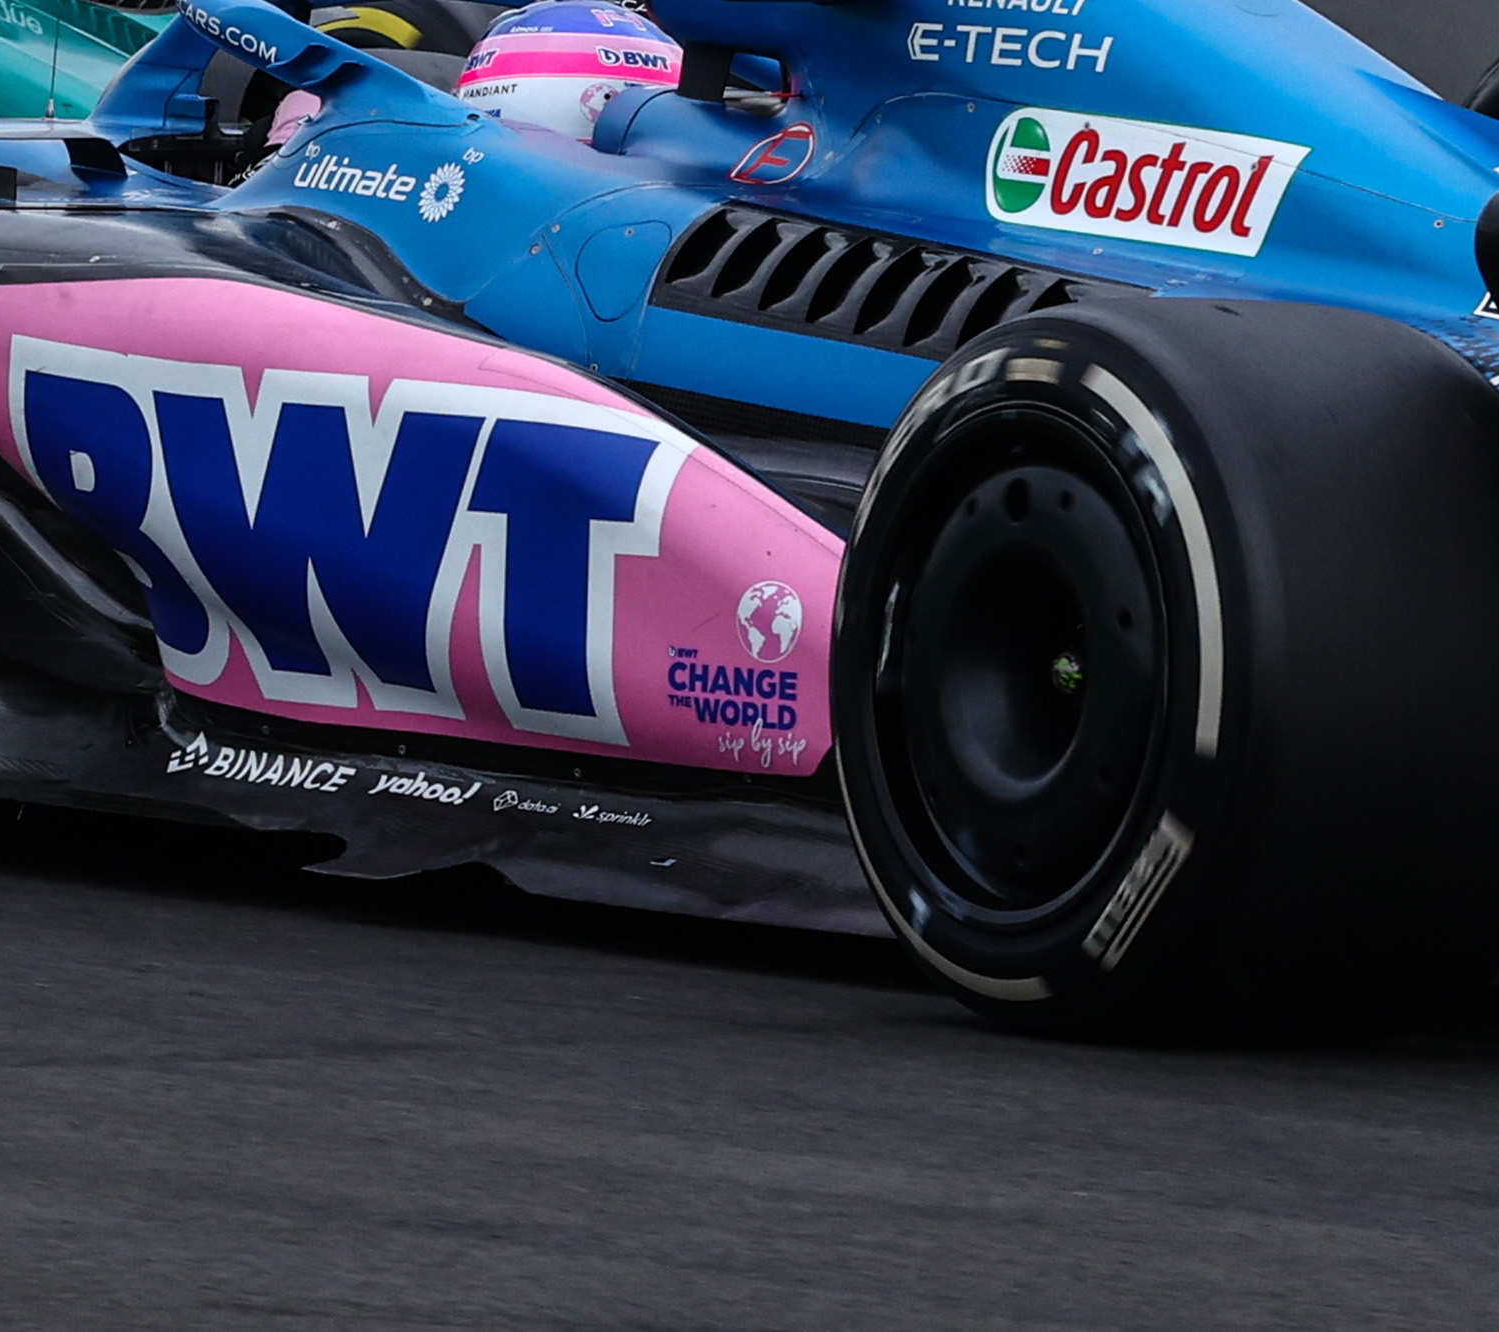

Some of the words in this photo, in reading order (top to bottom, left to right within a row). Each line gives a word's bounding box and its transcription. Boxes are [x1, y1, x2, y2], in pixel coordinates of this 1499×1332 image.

[623, 51, 672, 72] BWT
[906, 22, 1114, 73] E-TECH
[305, 140, 321, 159] bp
[463, 147, 485, 165] bp
[293, 154, 417, 202] ultimate
[1050, 128, 1276, 238] Castrol
[21, 364, 665, 722] BWT
[667, 661, 799, 701] CHANGE
[668, 694, 692, 708] THE
[694, 697, 797, 731] WORLD
[718, 732, 746, 762] sip
[751, 718, 774, 768] by
[777, 733, 807, 766] sip
[203, 746, 356, 794] BINANCE
[369, 771, 482, 806] yahoo!
[596, 810, 653, 828] sprinklr
